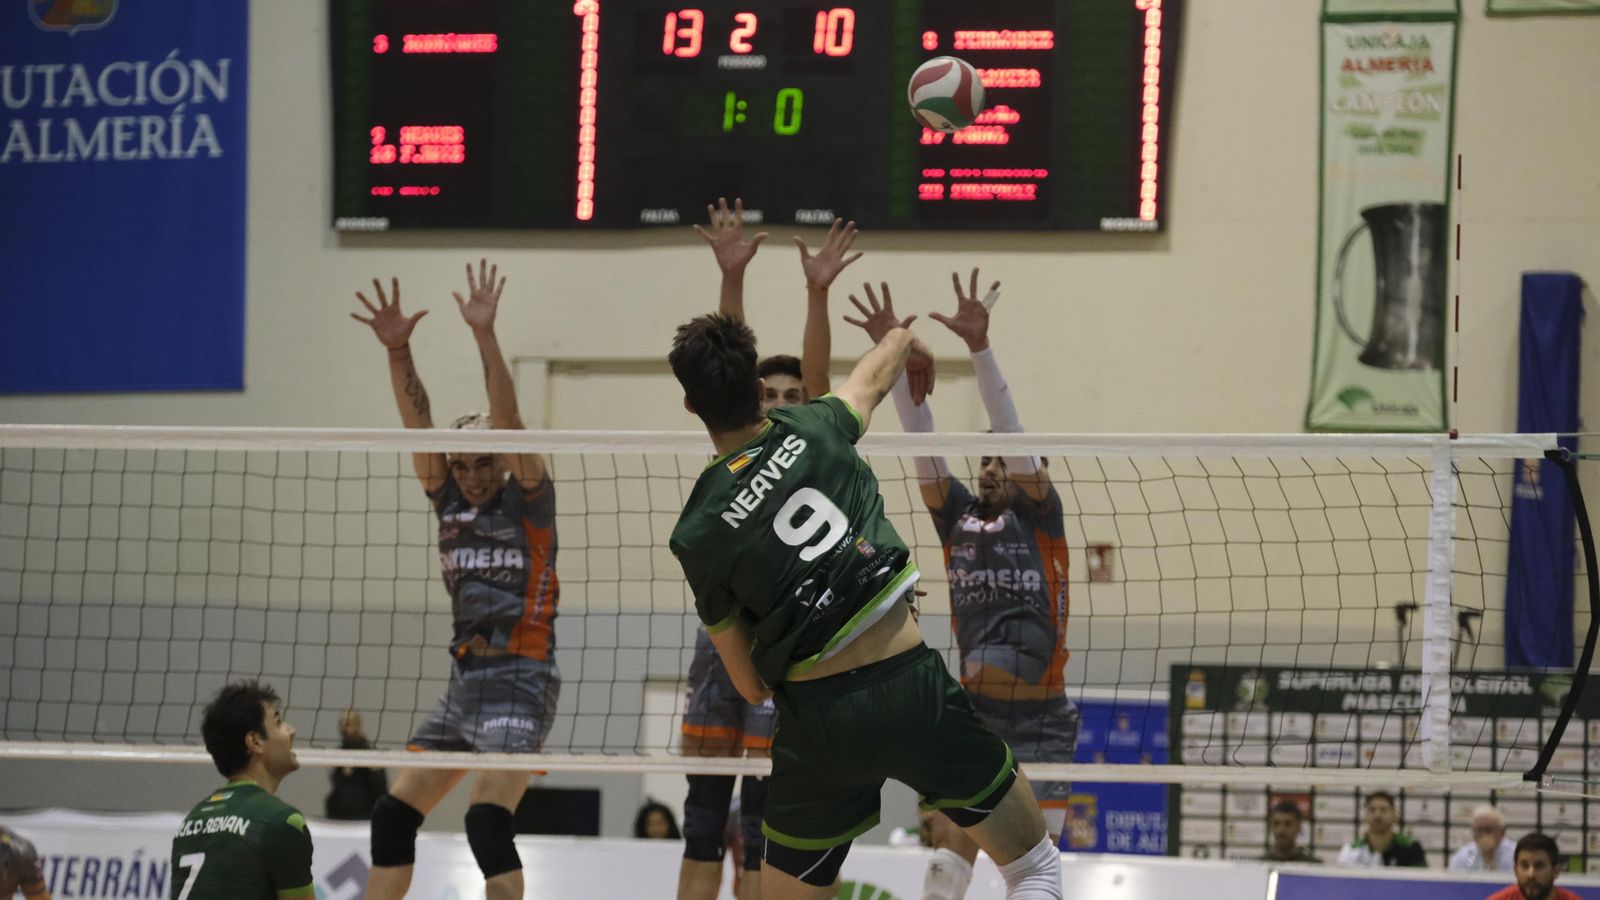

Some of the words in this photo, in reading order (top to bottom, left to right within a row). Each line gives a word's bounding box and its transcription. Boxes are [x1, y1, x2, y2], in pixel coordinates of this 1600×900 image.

[662, 9, 704, 57] 13
[729, 12, 758, 53] 2
[813, 8, 855, 56] 10
[0, 102, 224, 163] ALMERÍA
[774, 88, 804, 135] 0
[720, 434, 808, 529] NEAVES
[773, 487, 849, 562] 9
[178, 851, 206, 900] 7
